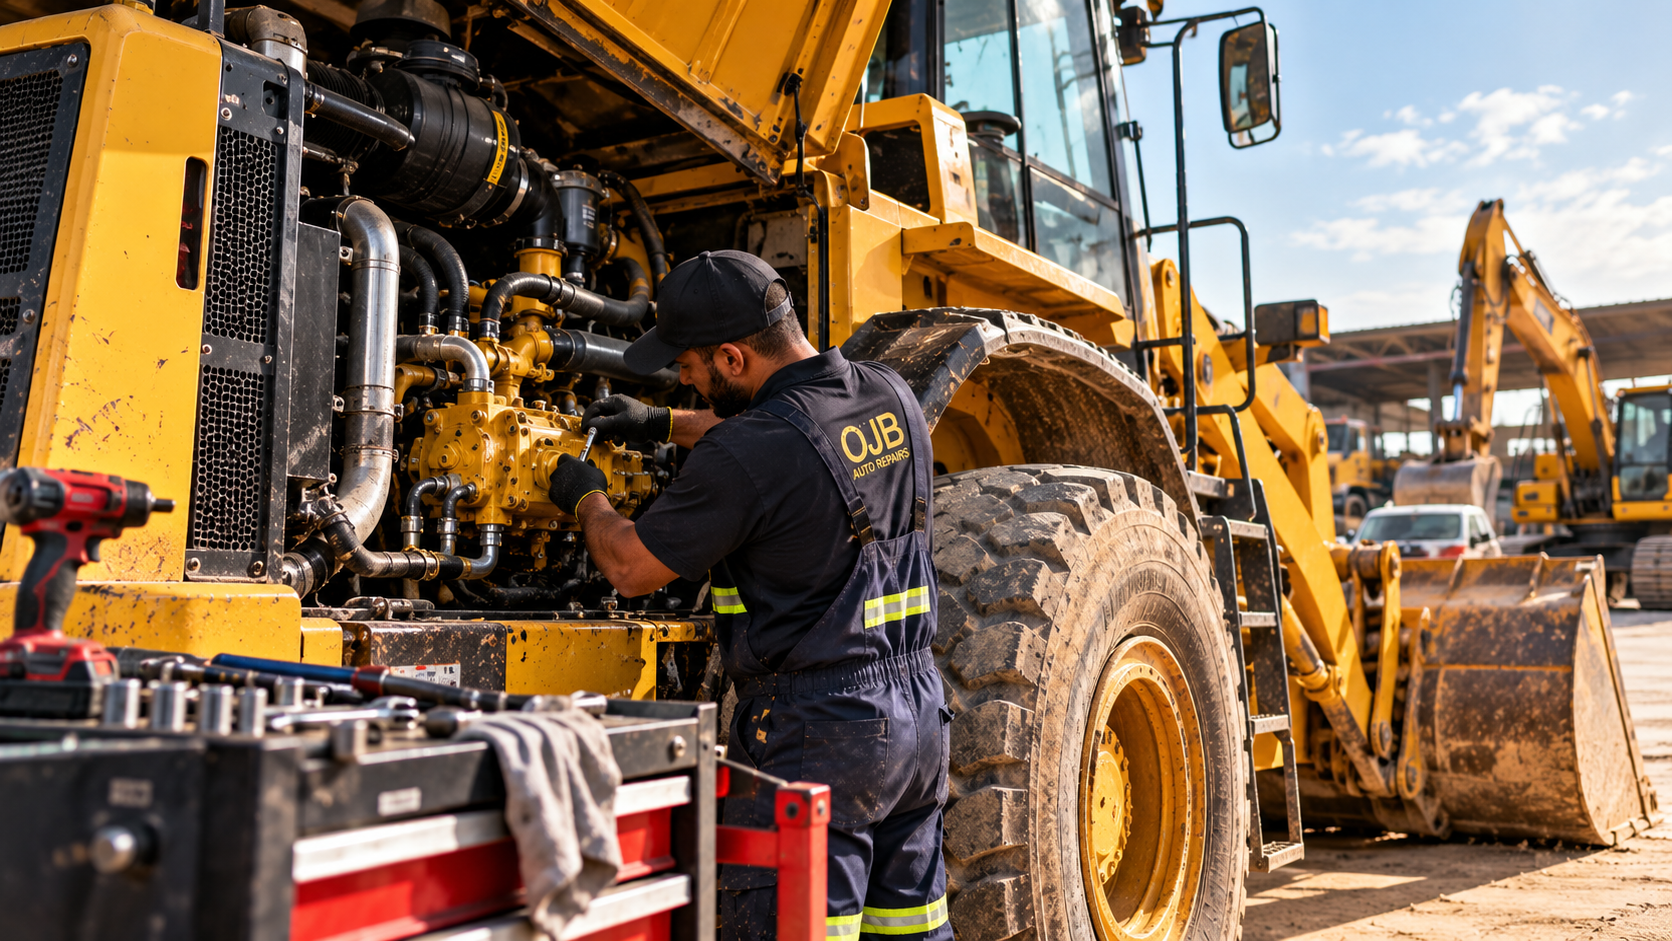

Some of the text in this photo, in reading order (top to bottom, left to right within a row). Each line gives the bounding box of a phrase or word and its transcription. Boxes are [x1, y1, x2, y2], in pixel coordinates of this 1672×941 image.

[841, 412, 904, 463] OJB
[853, 447, 910, 480] AUTO REPAIRS
